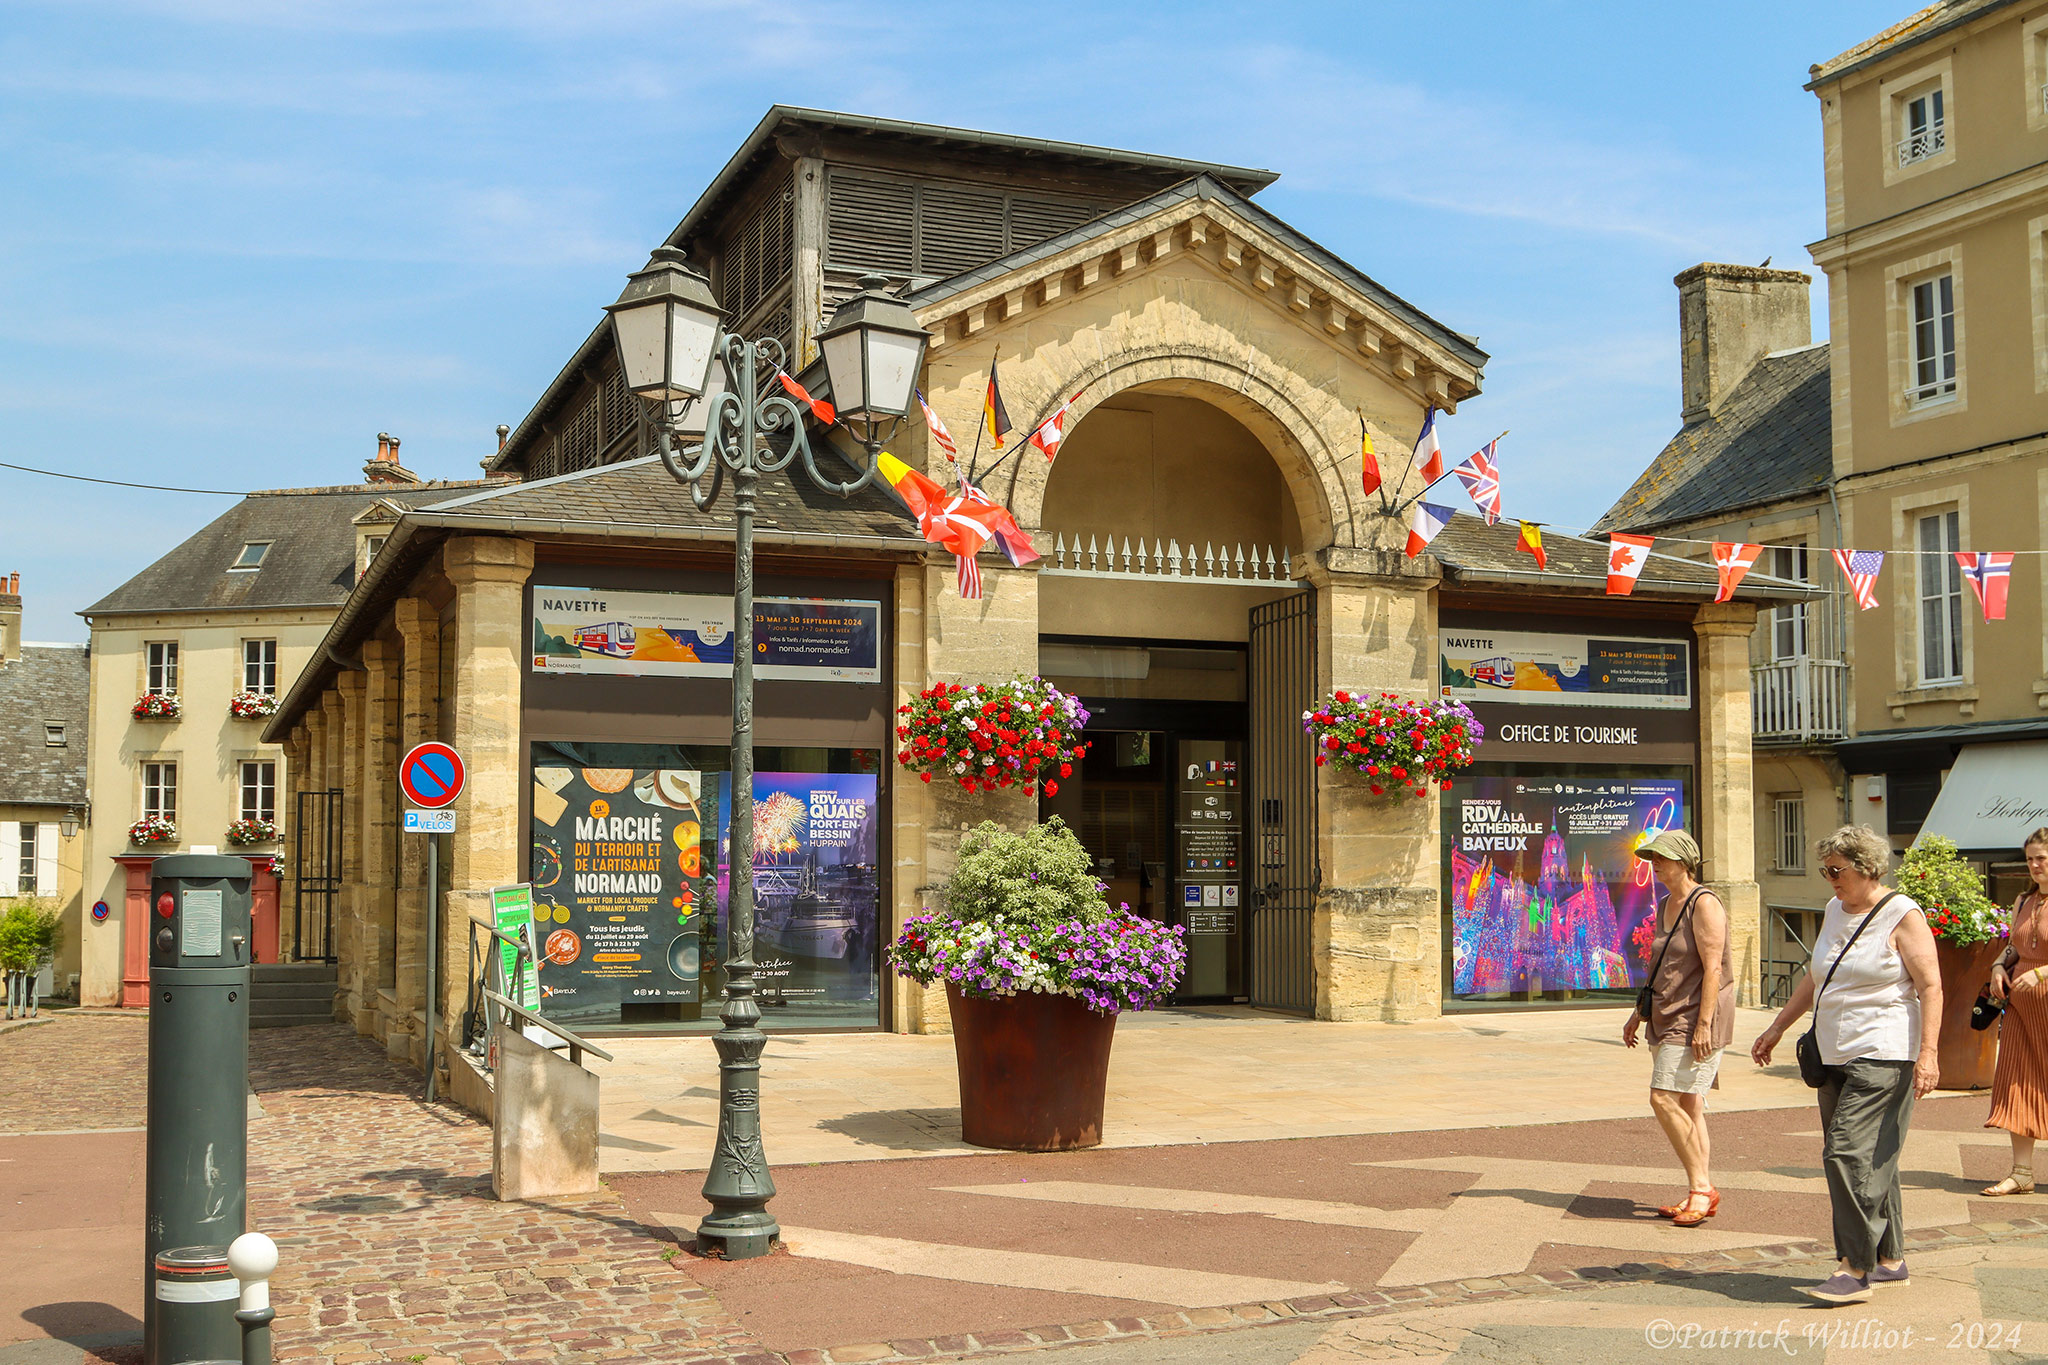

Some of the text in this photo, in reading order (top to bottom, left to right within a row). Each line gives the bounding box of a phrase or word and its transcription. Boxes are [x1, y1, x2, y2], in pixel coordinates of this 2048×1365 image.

[543, 599, 607, 612] NAVETTE
[778, 645, 851, 655] nomad.normandie.fr
[1447, 638, 1493, 649] NAVETTE
[1617, 676, 1669, 684] nomad.normandie.fr
[1500, 724, 1639, 745] OFFICE DE TOURISME
[810, 794, 838, 805] RDV
[810, 804, 867, 820] QUAIS
[1462, 805, 1526, 822] RDV À LA
[1976, 795, 2048, 828] Horloge
[407, 815, 417, 826] P
[419, 821, 452, 830] VELOS
[575, 812, 663, 841] MARCHÉ
[810, 820, 861, 829] PORT-EN-
[1462, 820, 1543, 834] CATHÉDRALE
[810, 830, 851, 839] BESSIN
[575, 842, 662, 857] DU TERROIR ET
[1462, 836, 1528, 851] BAYEUX
[575, 858, 662, 872] DE L'ARTISANAT
[574, 873, 662, 894] NORMAND
[632, 897, 658, 905] PRODUCE
[621, 925, 645, 933] jeudis
